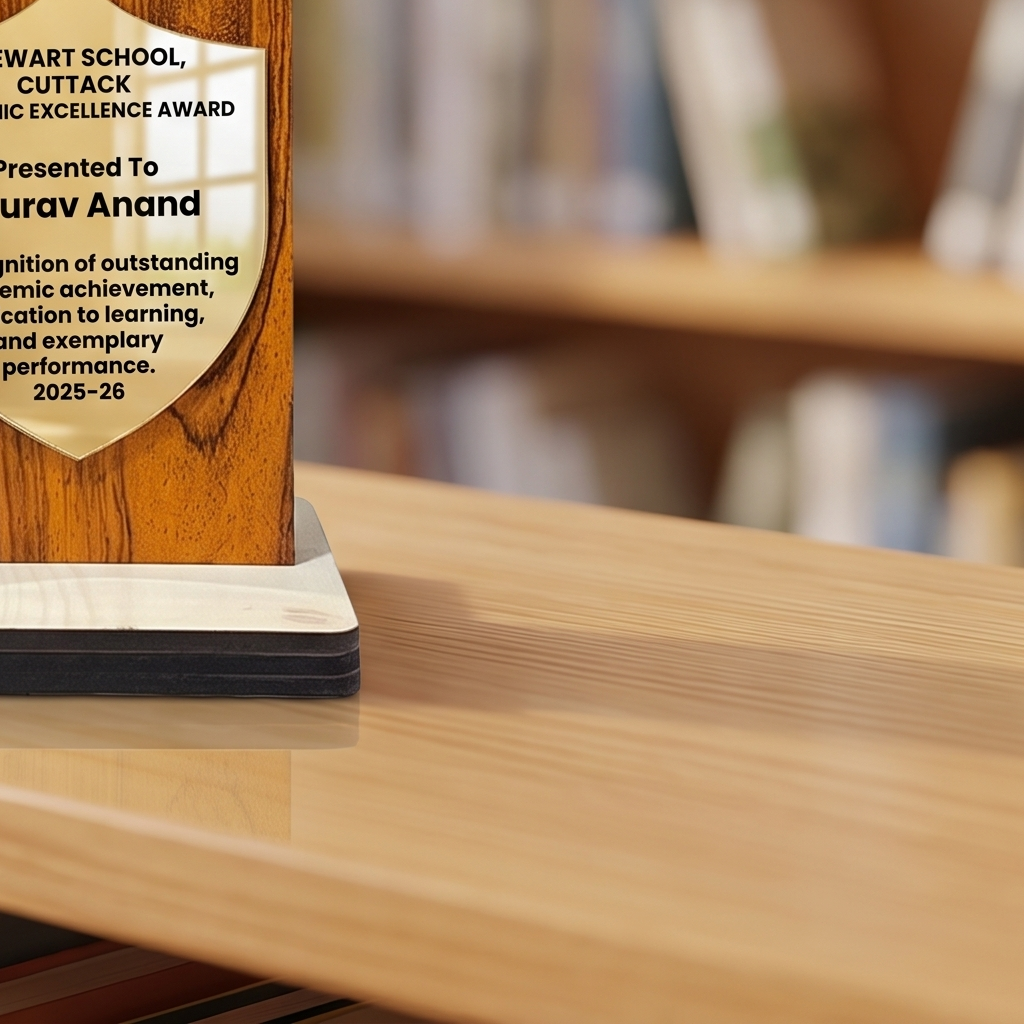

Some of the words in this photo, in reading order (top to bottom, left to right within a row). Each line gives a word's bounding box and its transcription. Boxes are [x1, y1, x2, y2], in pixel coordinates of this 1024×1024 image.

[81, 47, 186, 69] SCHOOL,
[17, 74, 131, 95] CUTTACK
[29, 101, 152, 120] EXCELLENCE
[157, 100, 235, 118] AWARD
[128, 157, 159, 177] To
[86, 189, 201, 218] Anand
[74, 253, 97, 273] of
[100, 251, 239, 276] outstanding
[59, 278, 215, 299] achievement,
[76, 306, 100, 324] to
[105, 303, 205, 328] learning,
[42, 330, 164, 355] exemplary
[2, 356, 156, 382] performance.
[33, 381, 125, 401] 2025-26
